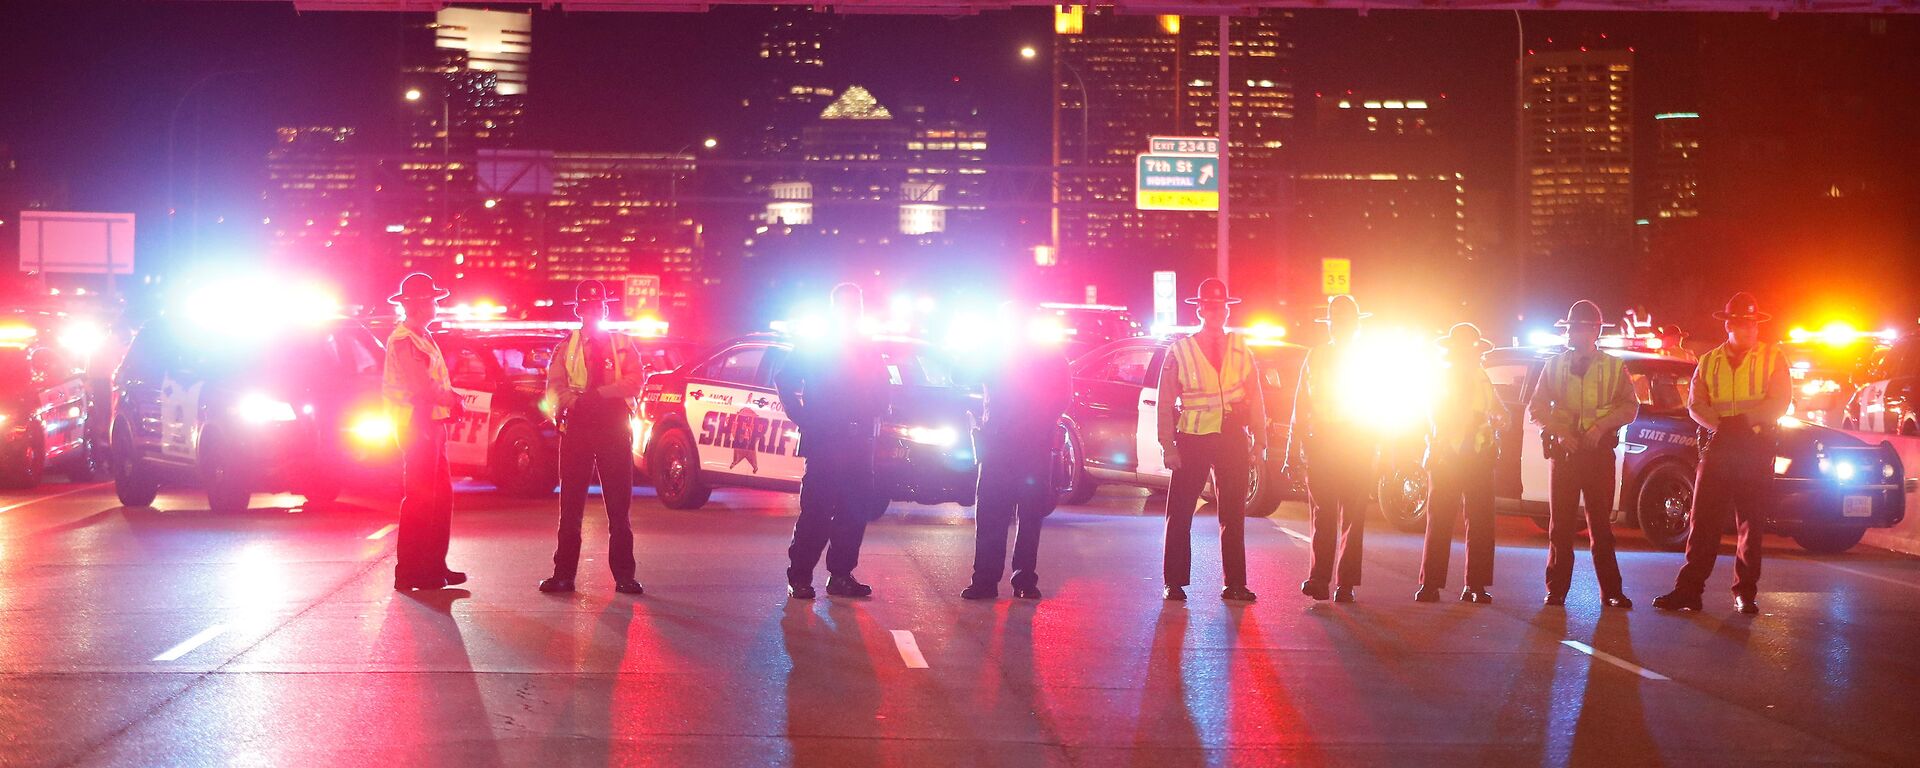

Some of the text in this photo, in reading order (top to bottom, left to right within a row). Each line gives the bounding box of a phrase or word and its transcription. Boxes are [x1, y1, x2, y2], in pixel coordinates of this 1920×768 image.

[1154, 142, 1175, 150] EXIT
[1145, 160, 1193, 172] 7th St
[1146, 176, 1194, 187] HOSPITAL
[1327, 274, 1346, 285] 35
[699, 410, 800, 457] SHERIF
[1639, 428, 1666, 441] STATE
